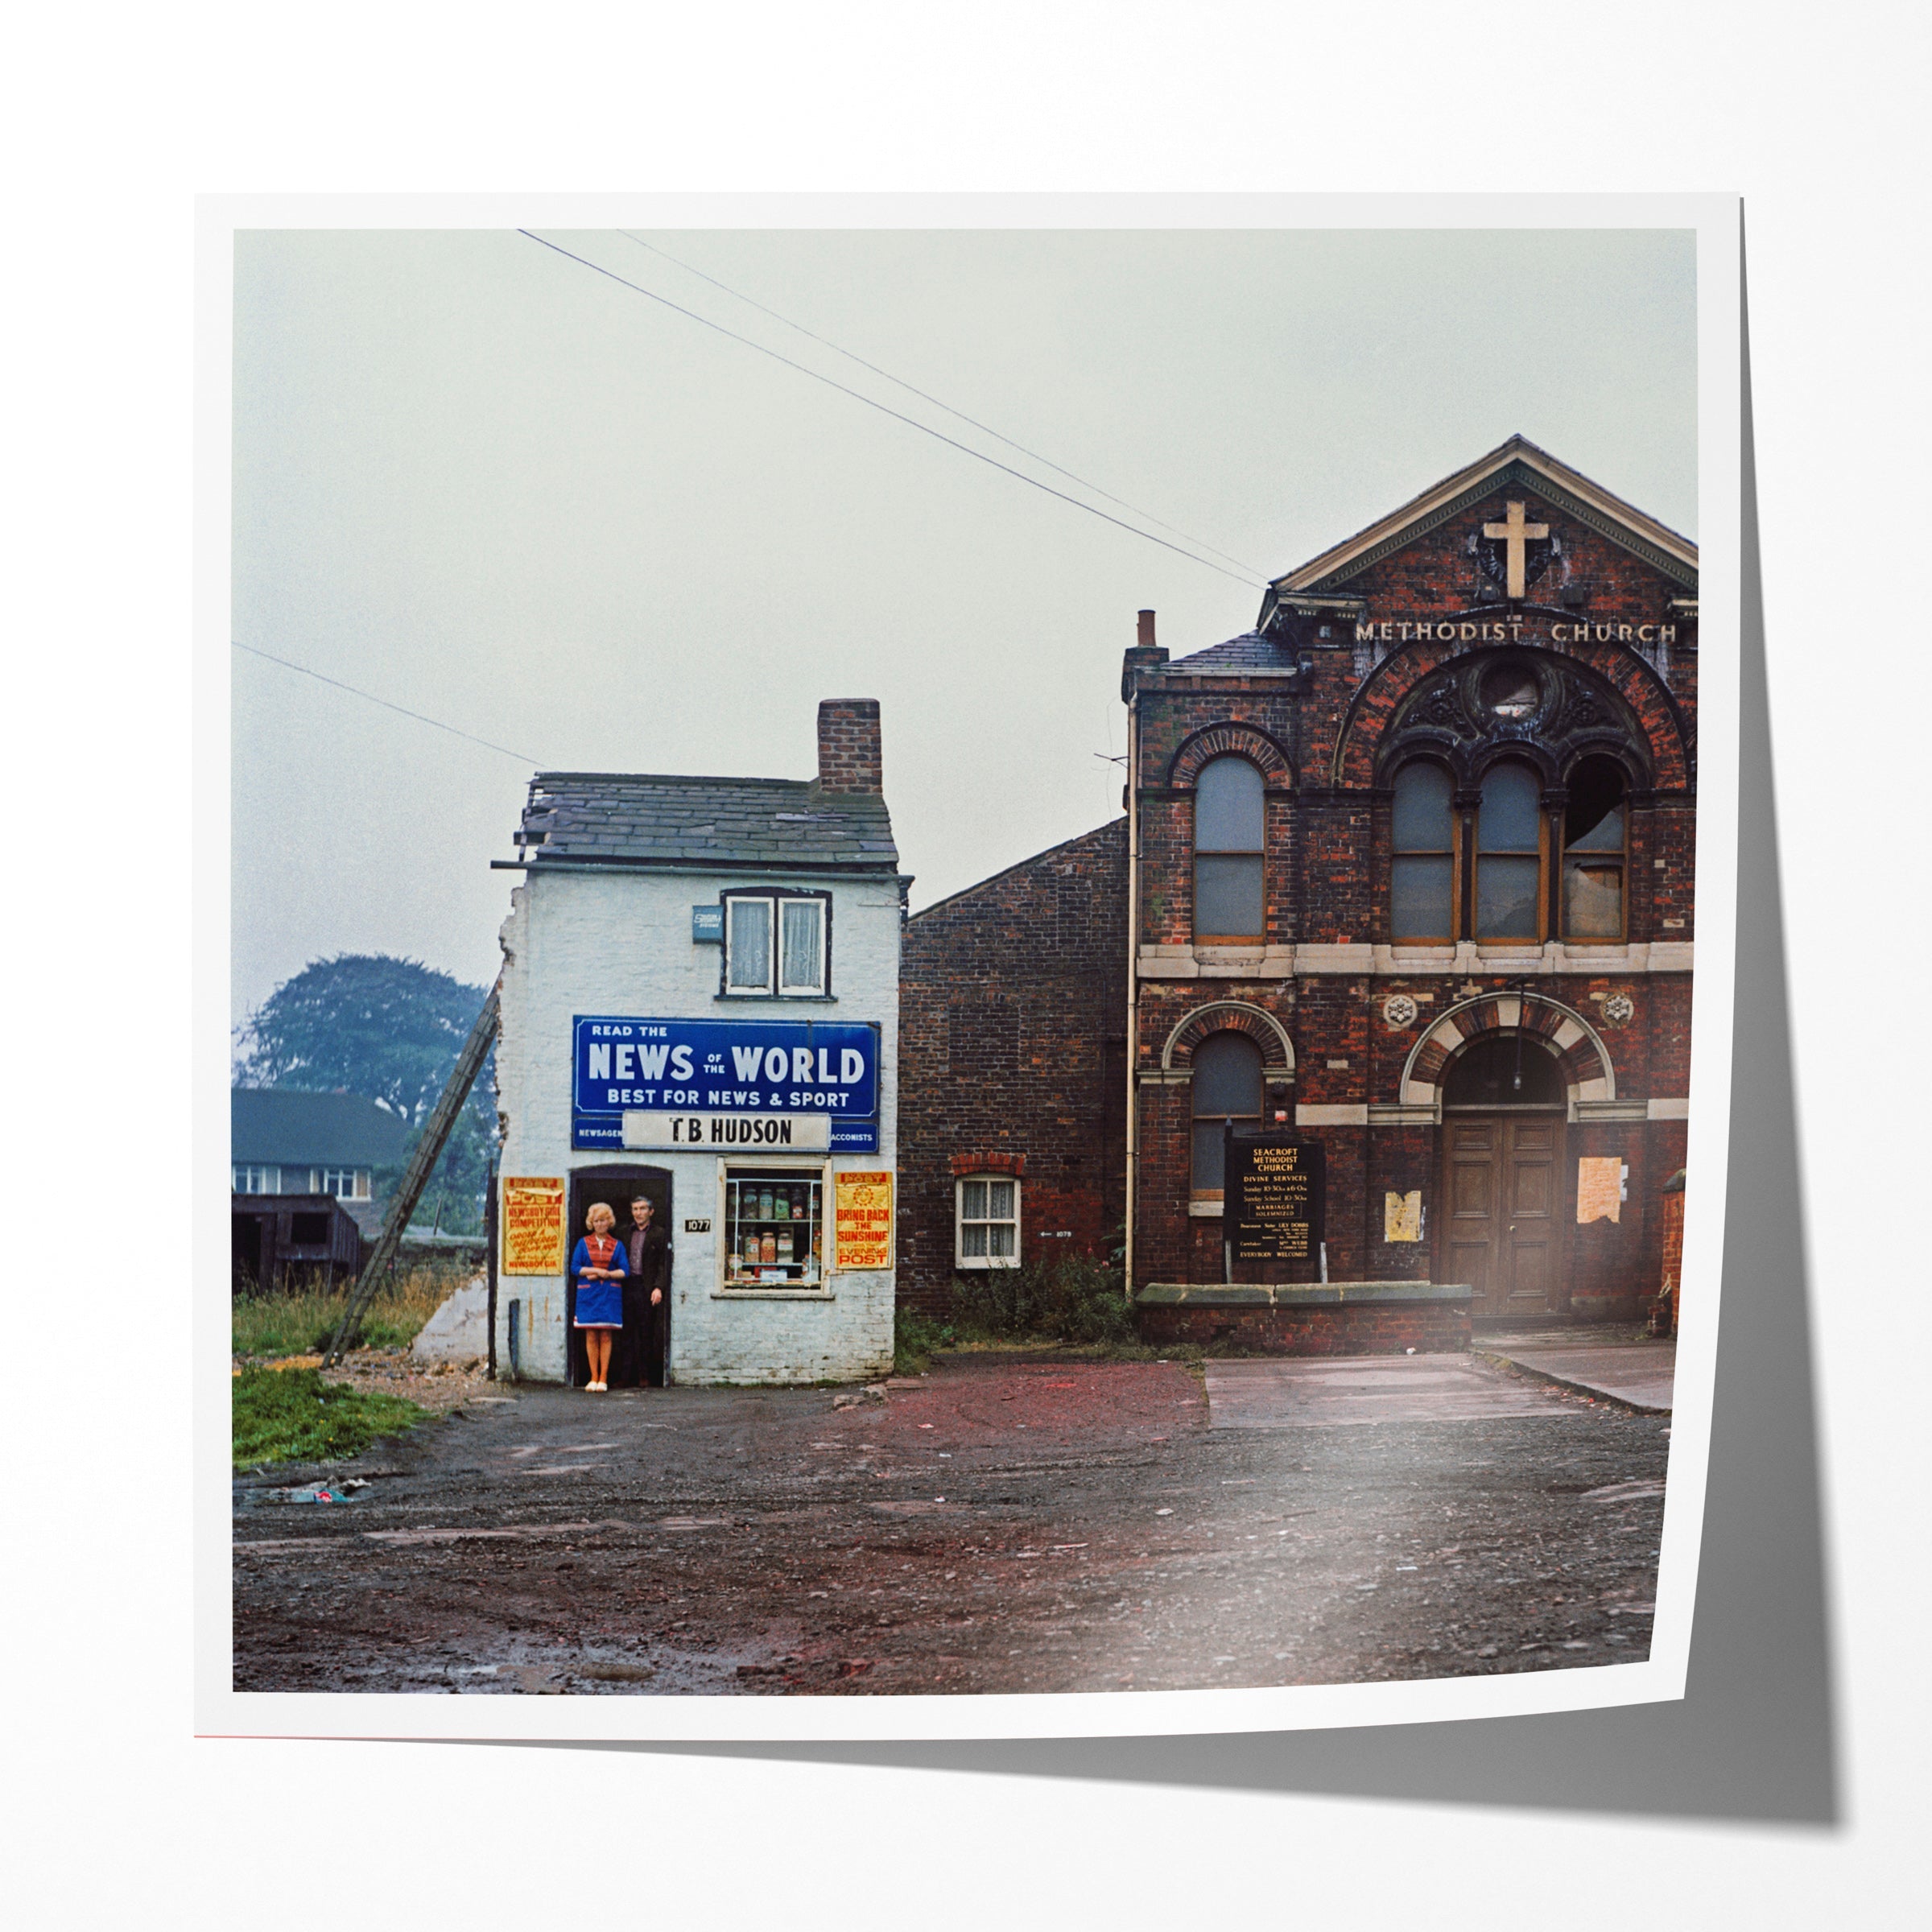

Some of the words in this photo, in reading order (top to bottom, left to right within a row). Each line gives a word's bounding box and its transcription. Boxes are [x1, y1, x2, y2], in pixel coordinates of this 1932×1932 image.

[1356, 622, 1523, 642] METHODIST
[1551, 623, 1676, 642] CHURCH
[592, 1026, 633, 1037] READ
[639, 1026, 667, 1037] THE
[588, 1043, 694, 1081] NEWS
[707, 1054, 722, 1063] OF
[703, 1064, 724, 1074] THE
[732, 1046, 865, 1084] WORLD
[608, 1089, 656, 1104] BEST
[663, 1090, 699, 1104] FOR
[708, 1091, 761, 1105] NEWS
[770, 1092, 783, 1106] &
[789, 1092, 850, 1107] SPORT
[711, 1118, 792, 1144] HUDSON
[837, 1209, 865, 1221] BRING
[867, 1209, 889, 1221] BACK
[510, 1218, 560, 1228] COMPETITION
[688, 1220, 710, 1230] 1077
[854, 1222, 872, 1230] THE
[838, 1231, 888, 1241] SUNSHINE
[839, 1254, 887, 1265] POST
